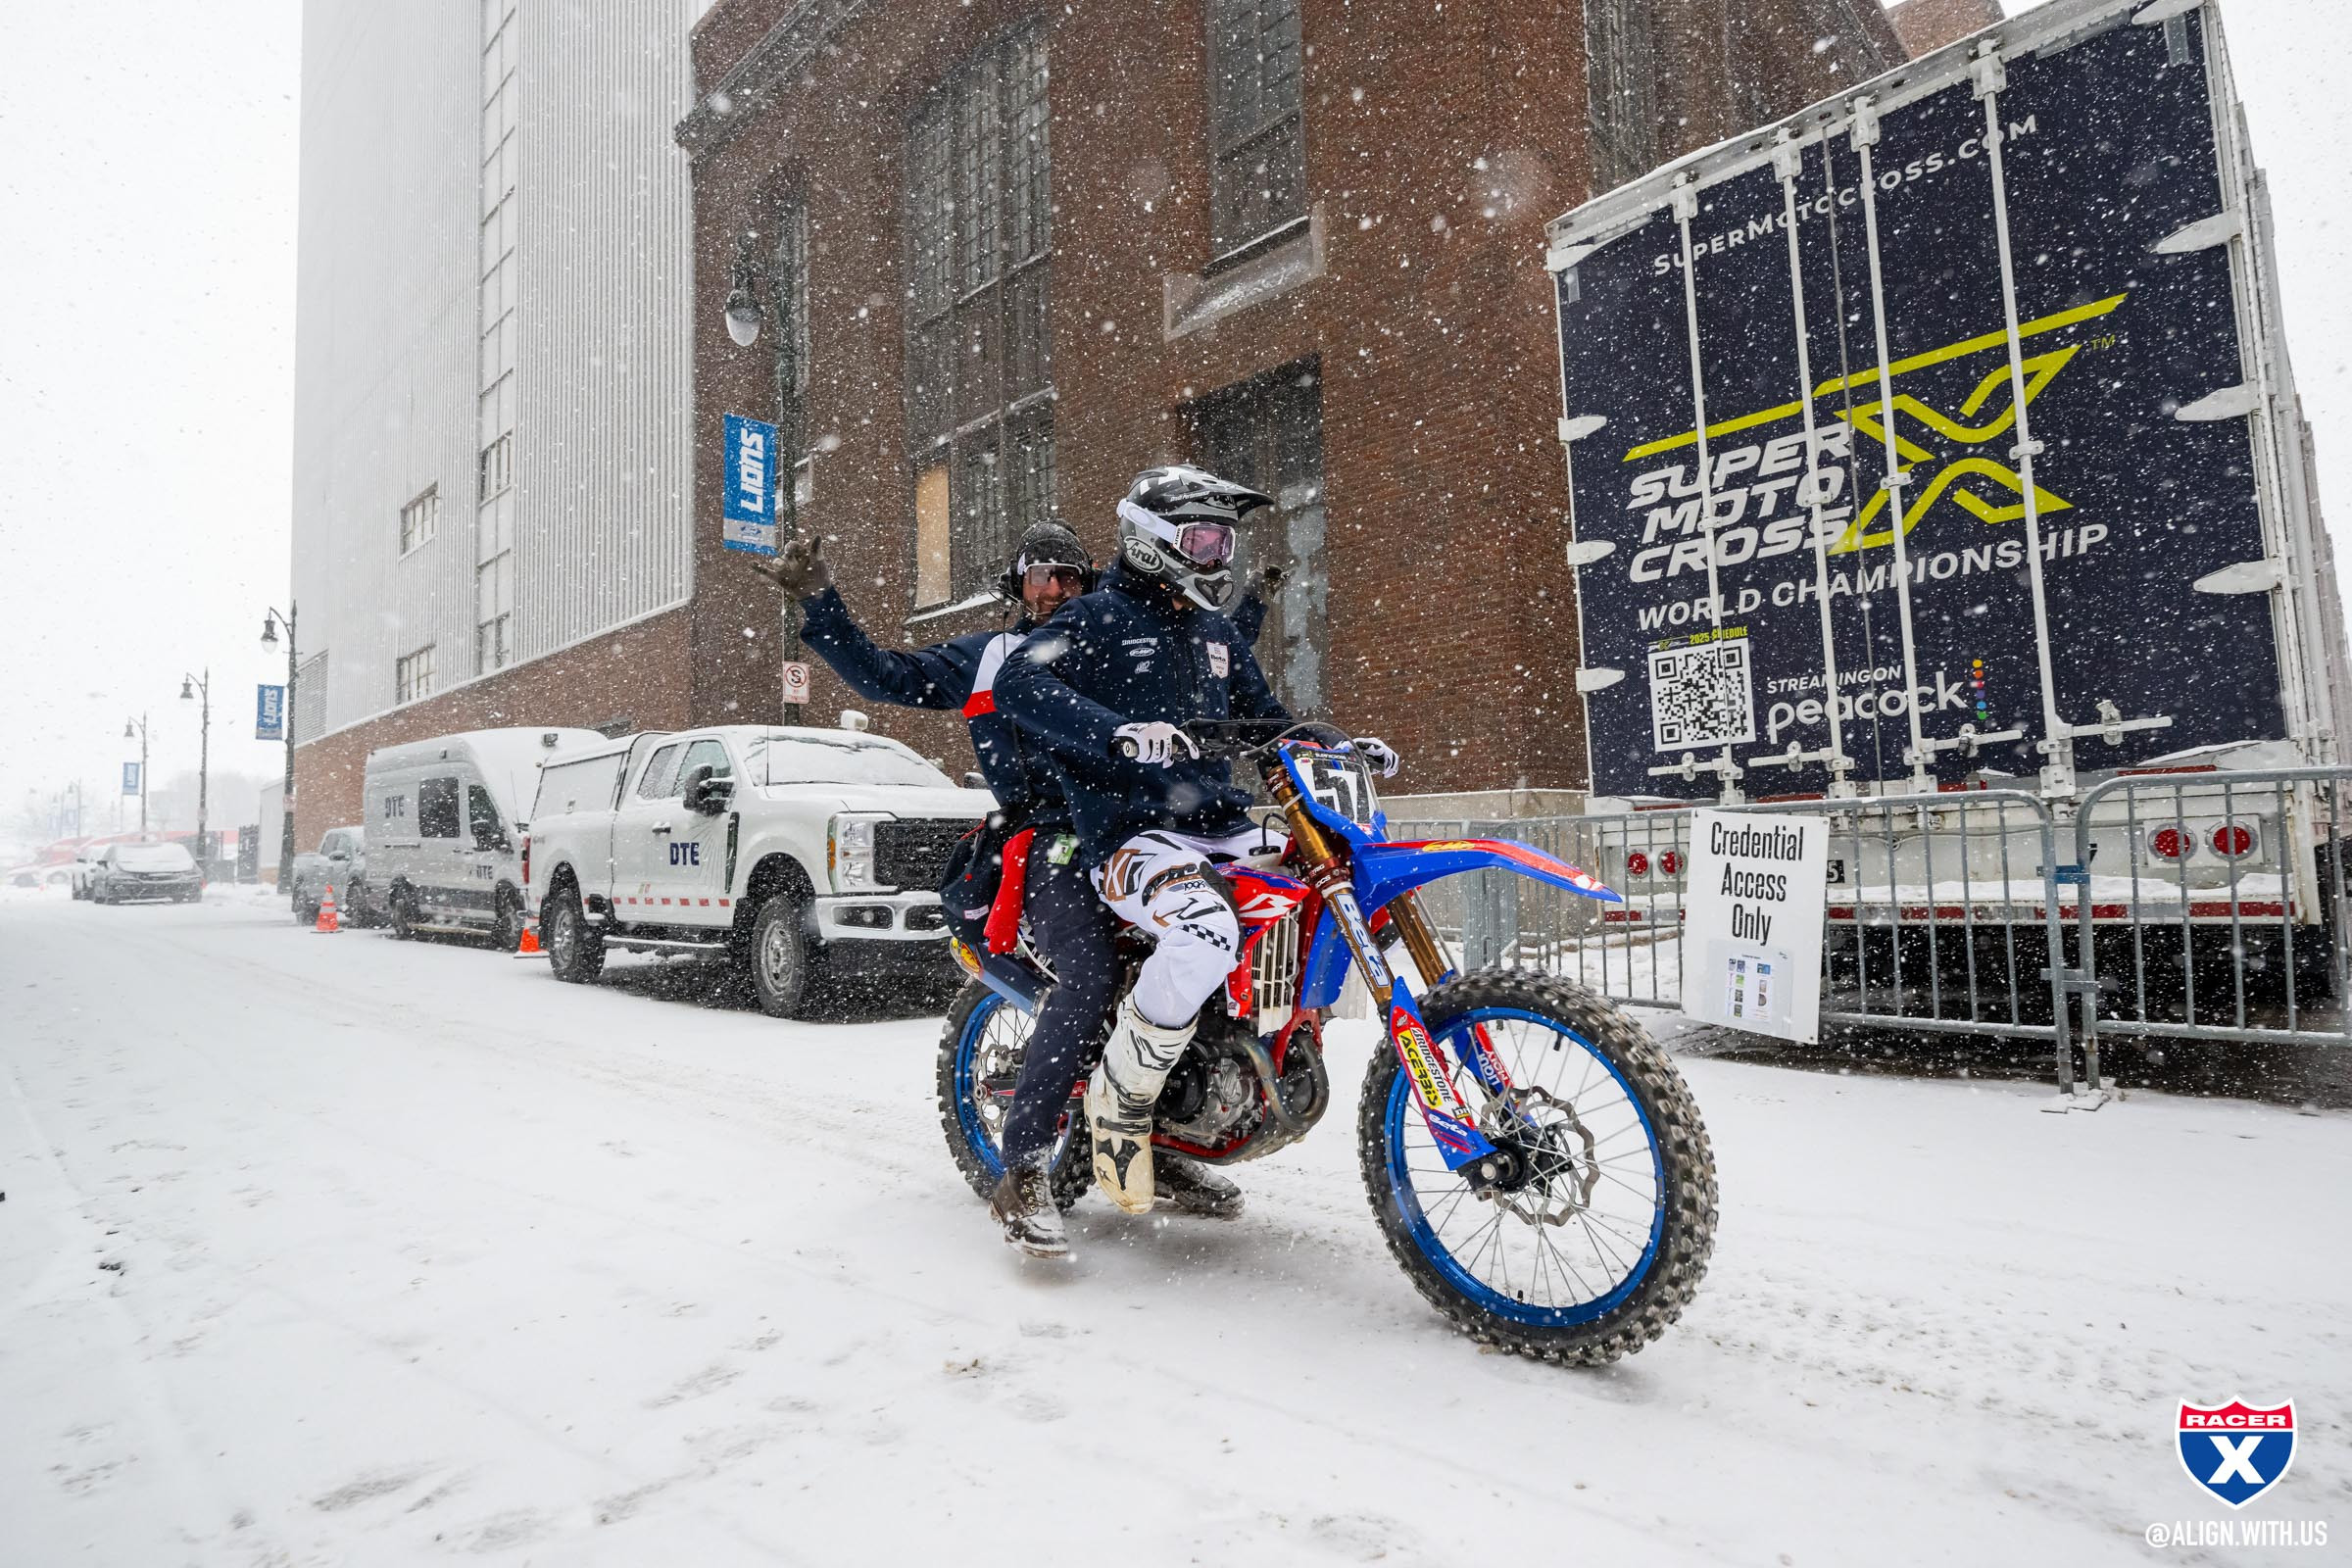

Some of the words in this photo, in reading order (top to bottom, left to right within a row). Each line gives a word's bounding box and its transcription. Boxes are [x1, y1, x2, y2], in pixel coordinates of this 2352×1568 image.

[1654, 115, 2036, 275] SUPERMOTOCOSS.COM
[2090, 334, 2116, 350] TM
[740, 427, 763, 514] LIONS
[1626, 421, 1854, 510] SUPER
[1642, 466, 1844, 544] MOTO
[1127, 541, 1159, 566] Arai
[1630, 506, 1851, 583] CROSS
[1639, 588, 1761, 630] WORLD
[1772, 523, 2108, 607] CHAMPIONSHIP
[1690, 632, 1710, 645] 2025
[1873, 665, 1901, 681] ON
[1768, 671, 1968, 744] peacock
[669, 842, 699, 865] DTE
[1711, 821, 1804, 860] Credential
[1721, 862, 1787, 902] Access
[1334, 893, 1392, 988] Beta
[1732, 904, 1772, 946] Only
[1411, 1029, 1452, 1103] BRIDGESTONE
[1478, 1053, 1500, 1086] LIQUI
[1483, 1046, 1509, 1082] MOLY
